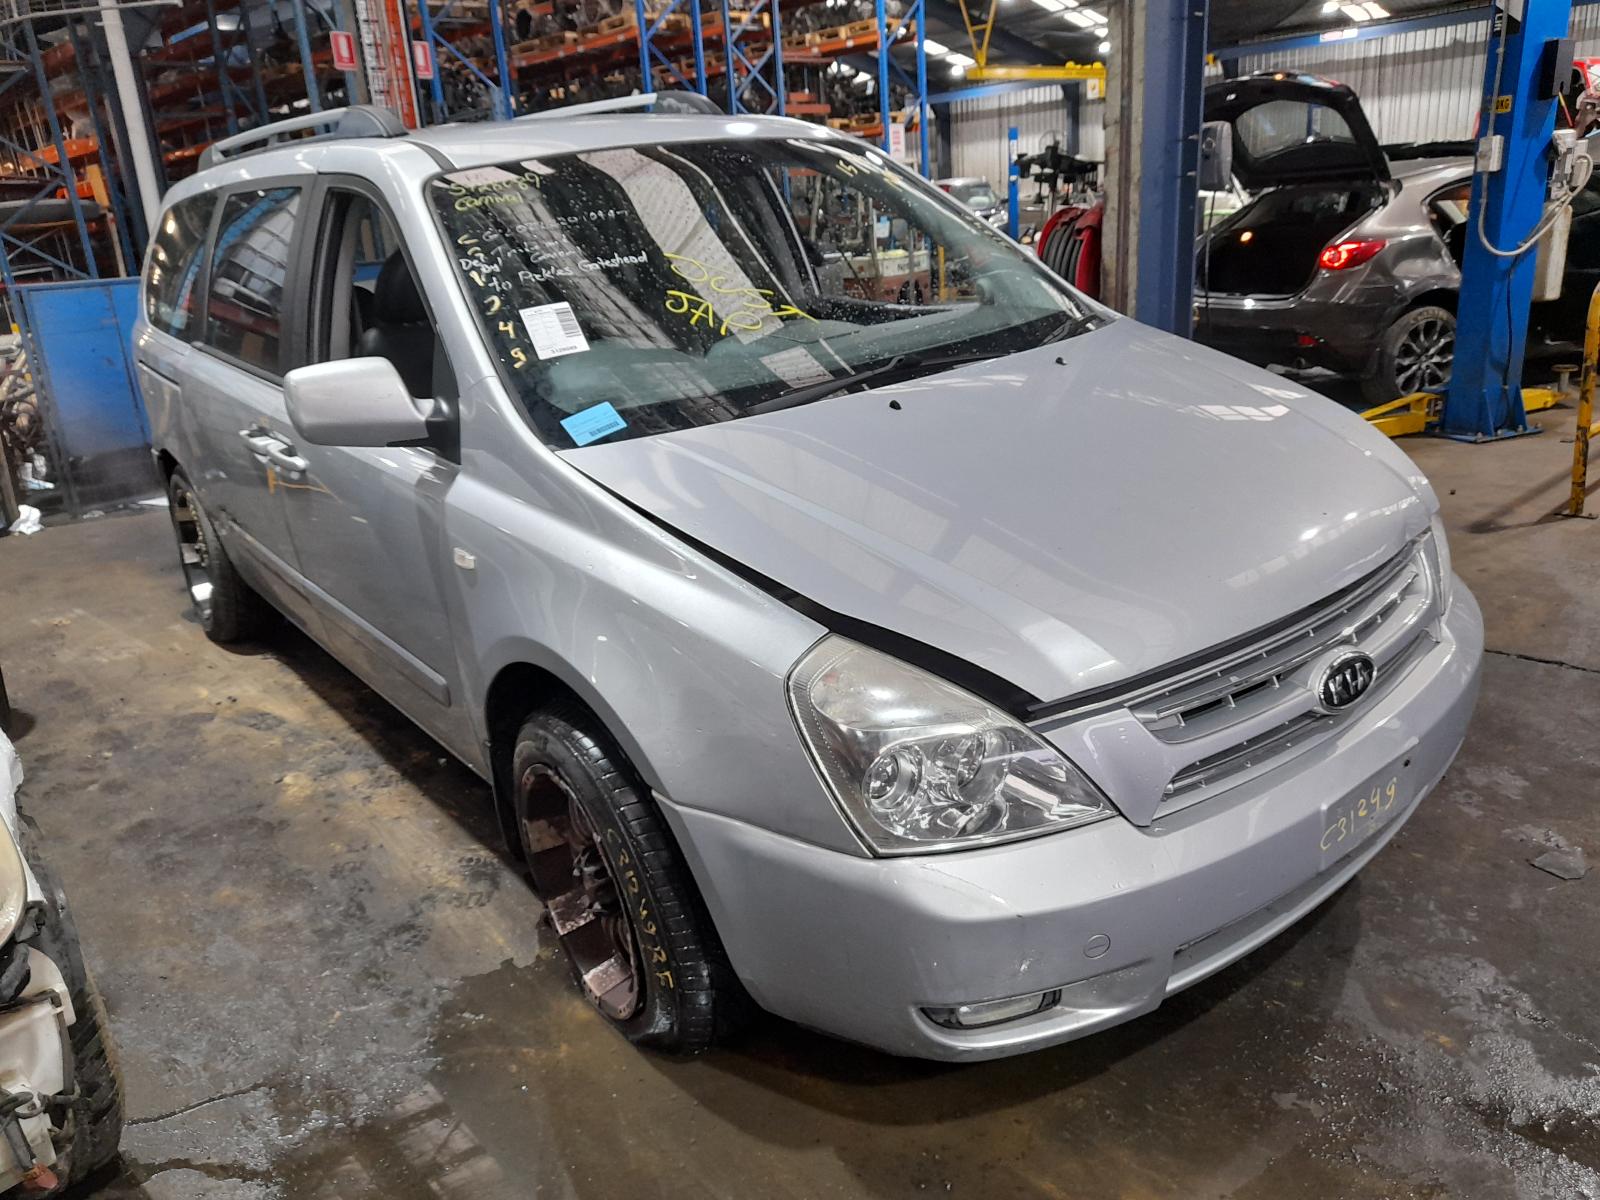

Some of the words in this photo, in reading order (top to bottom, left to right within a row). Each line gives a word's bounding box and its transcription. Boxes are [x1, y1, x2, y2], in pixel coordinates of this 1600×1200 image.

[664, 289, 763, 336] JAP
[1327, 661, 1370, 705] KIA
[1320, 776, 1398, 850] C31249
